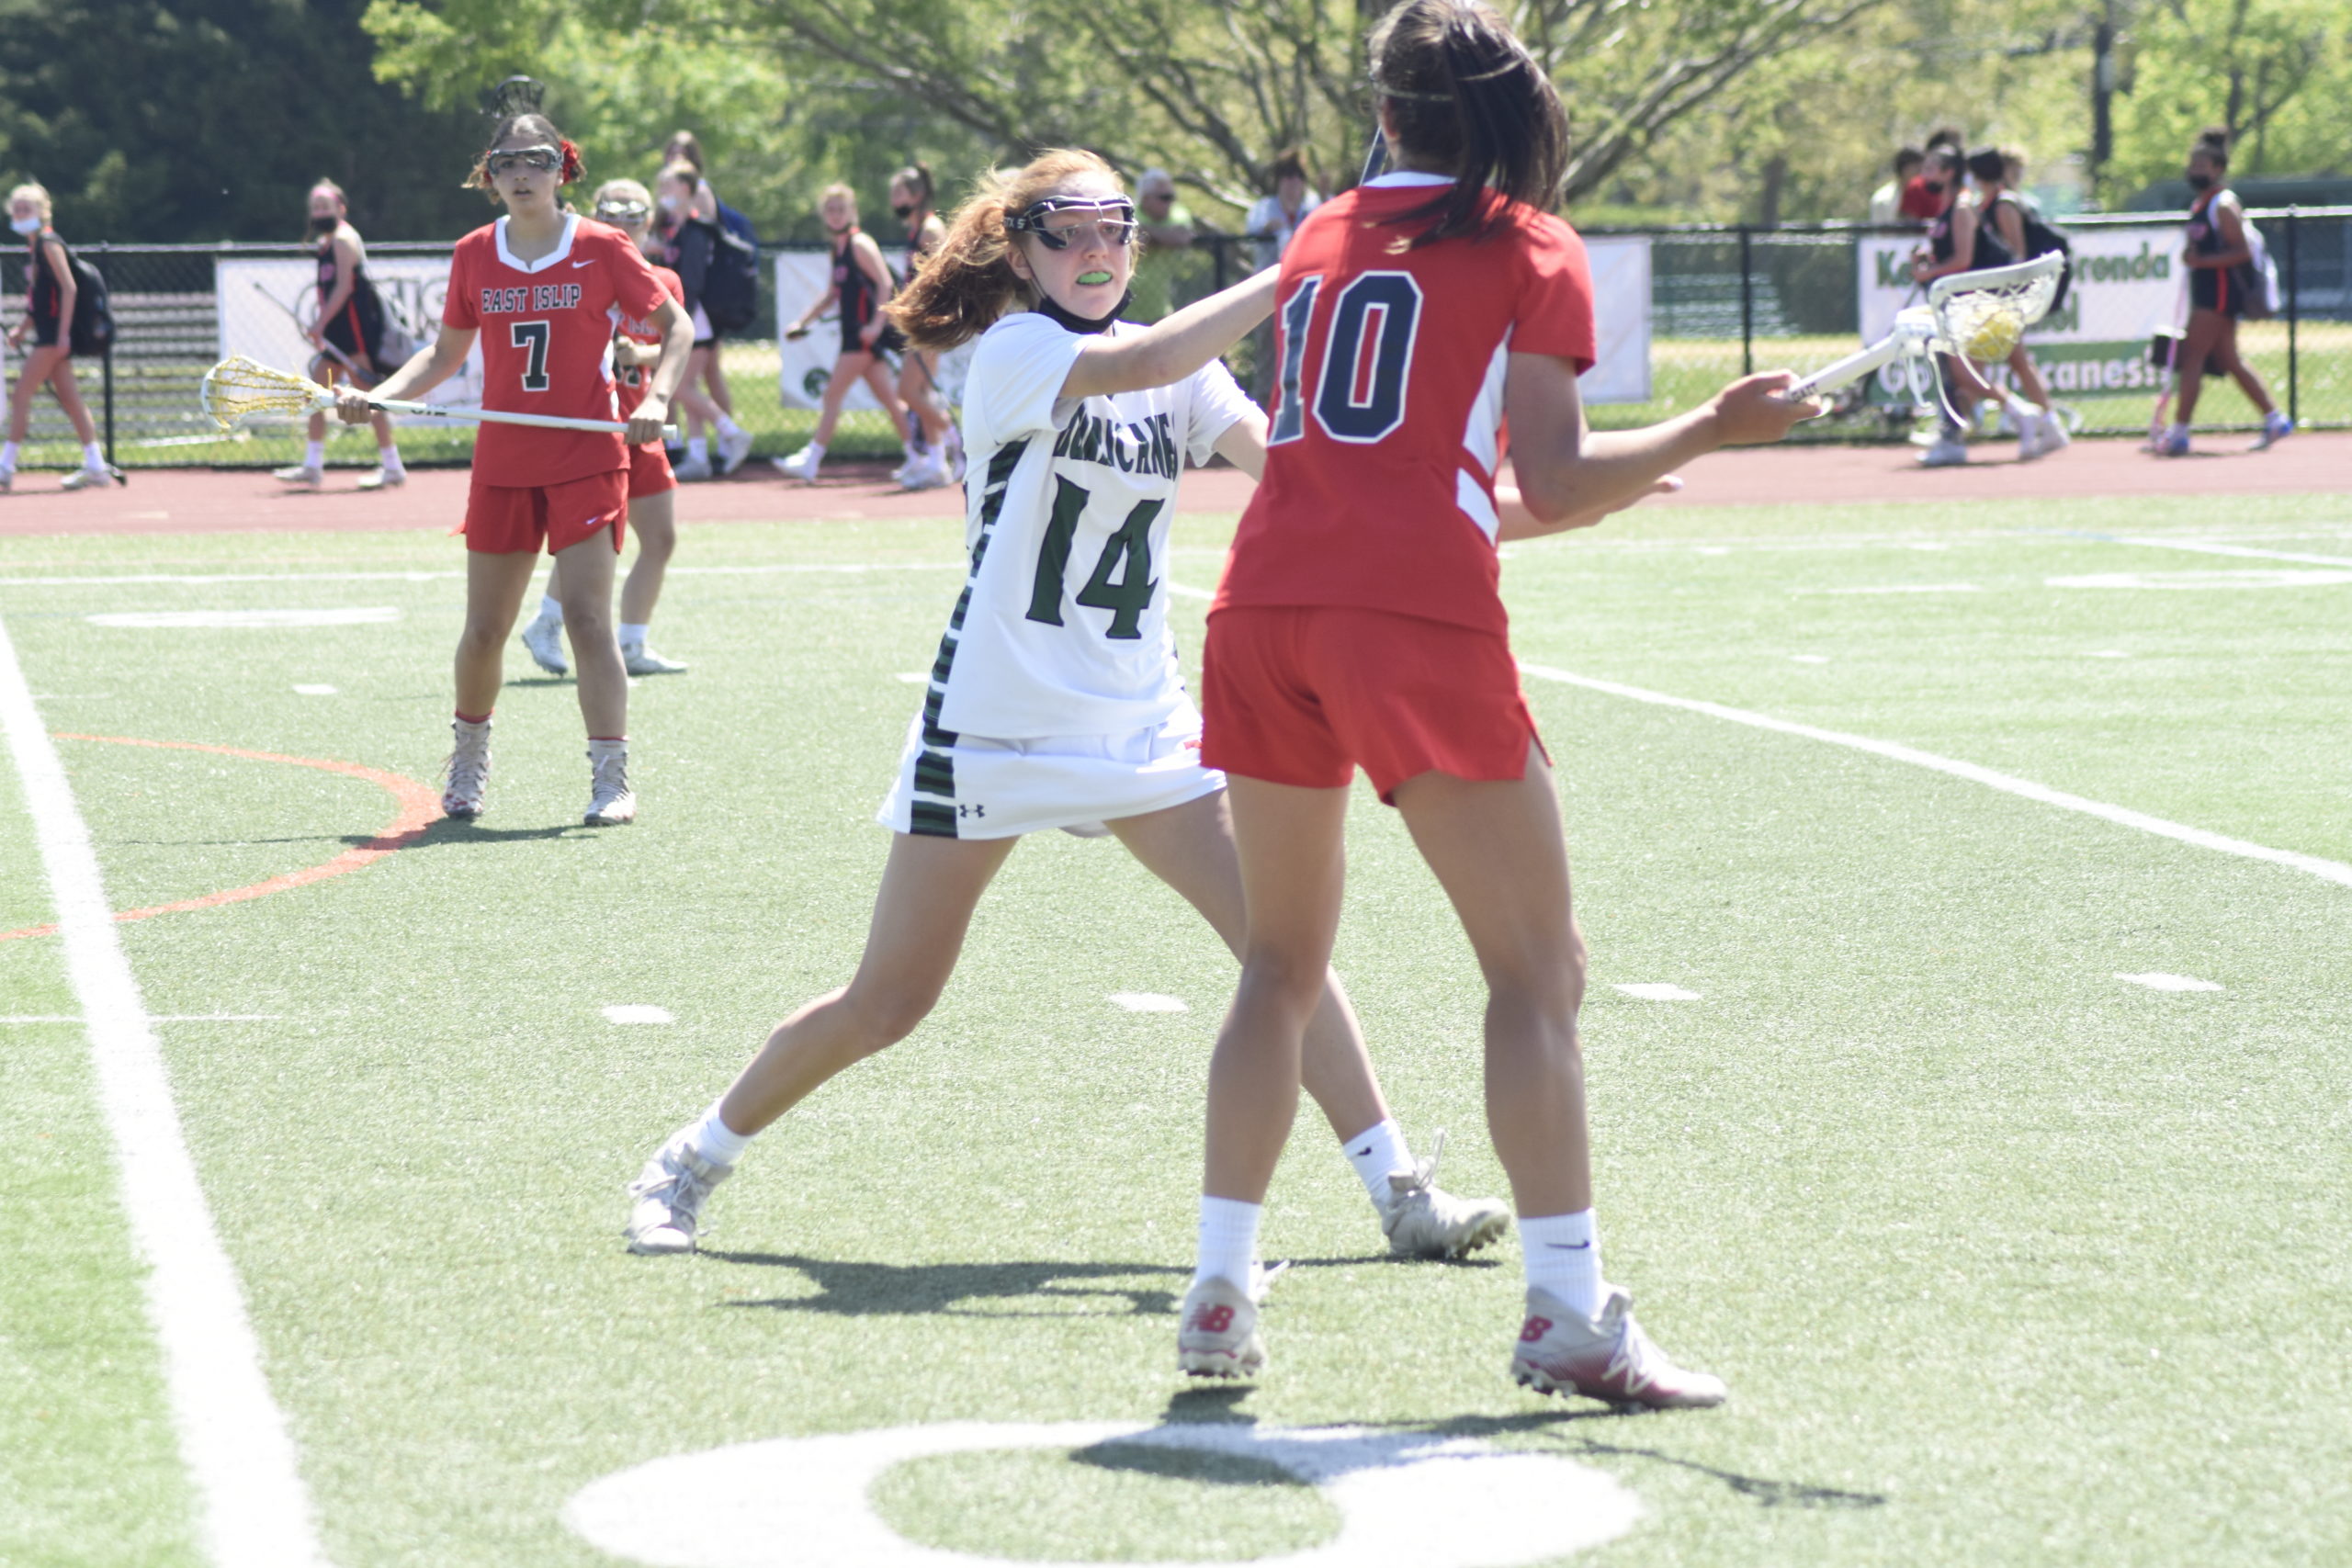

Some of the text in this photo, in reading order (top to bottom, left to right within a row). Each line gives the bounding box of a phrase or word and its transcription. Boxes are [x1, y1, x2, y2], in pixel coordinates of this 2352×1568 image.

[482, 284, 582, 312] EAST ISLIP
[511, 320, 549, 392] 7
[1267, 270, 1424, 447] 10
[1024, 471, 1166, 640] 14
